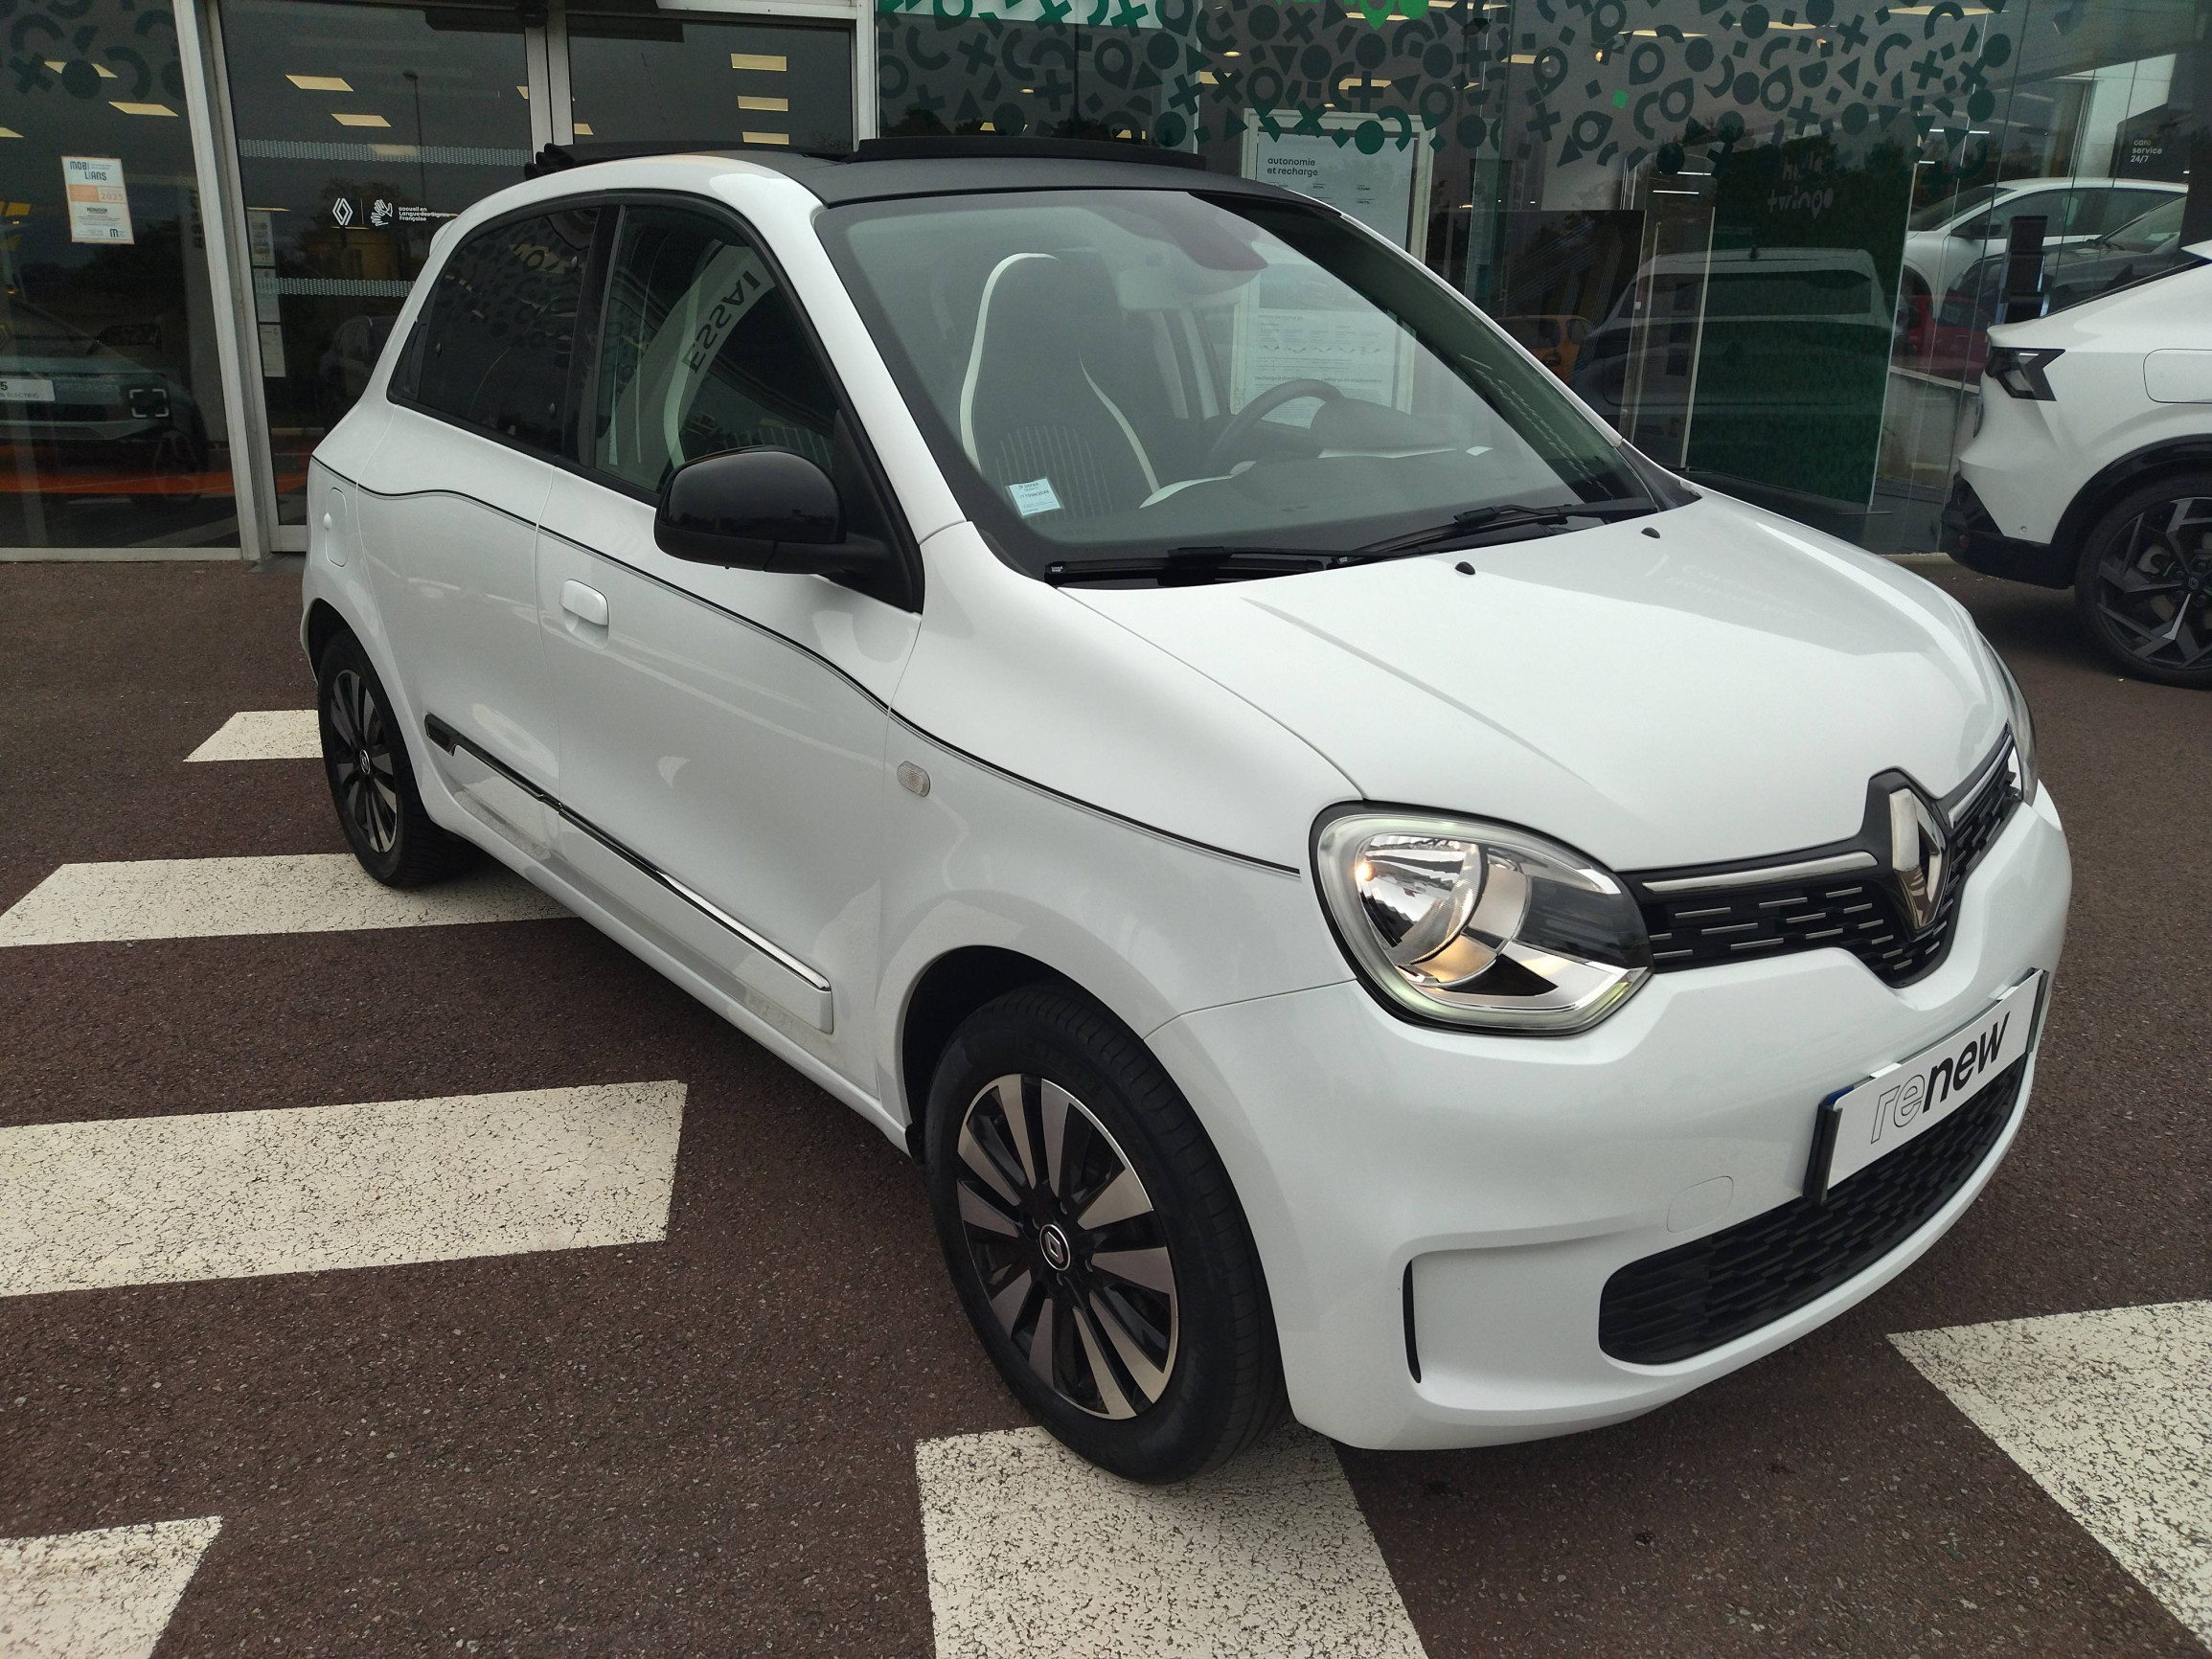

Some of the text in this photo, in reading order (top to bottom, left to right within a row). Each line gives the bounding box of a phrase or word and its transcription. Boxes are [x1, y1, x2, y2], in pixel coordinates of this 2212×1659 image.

[1267, 157, 1316, 167] autonomie
[1277, 167, 1318, 178] recharge
[101, 193, 125, 201] 2025
[1870, 1010, 2011, 1146] renew
